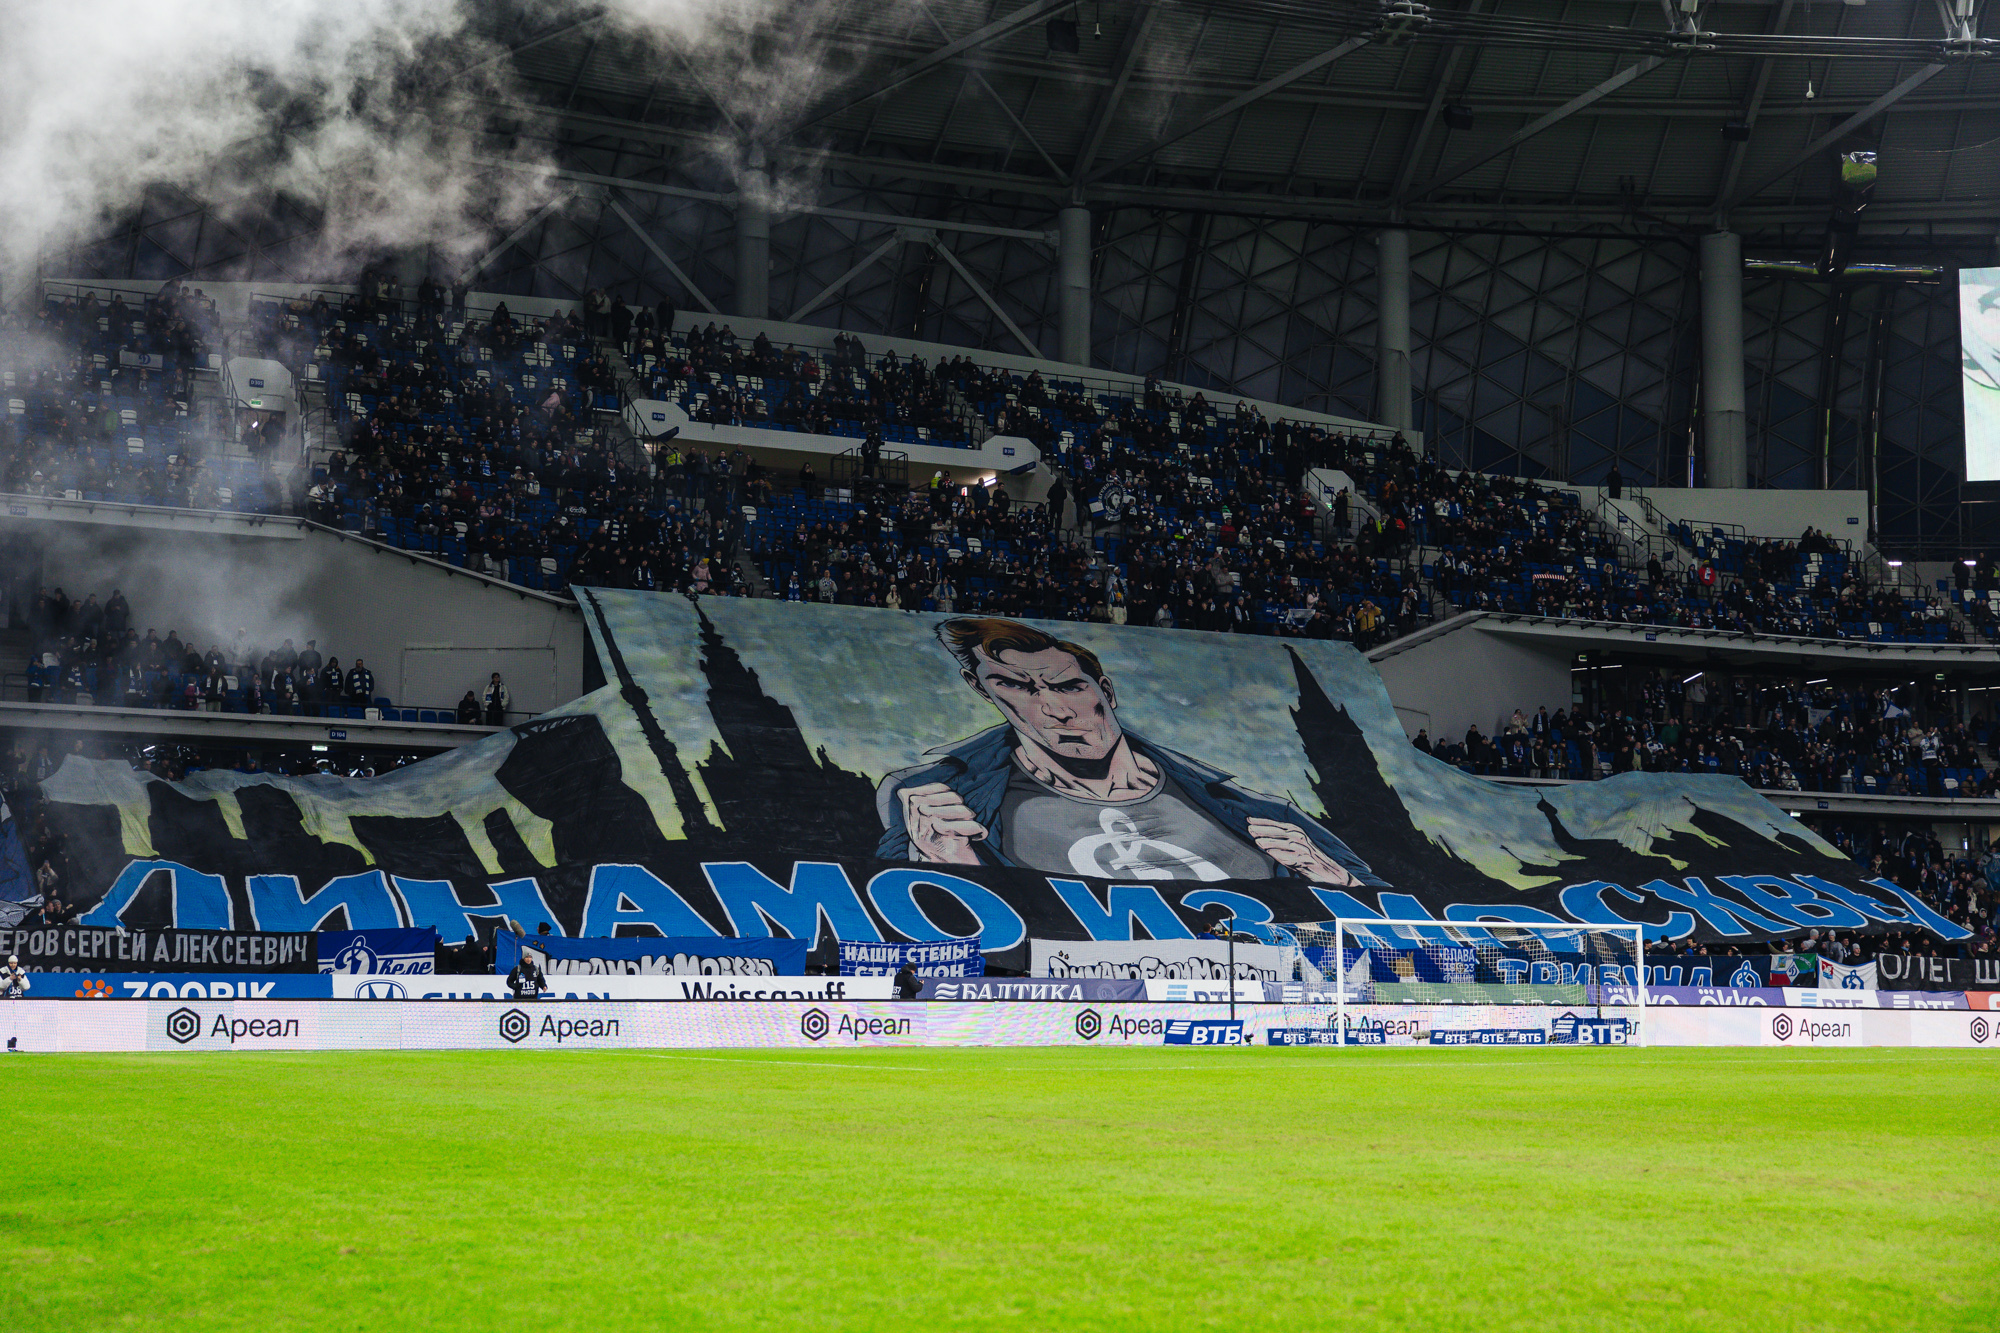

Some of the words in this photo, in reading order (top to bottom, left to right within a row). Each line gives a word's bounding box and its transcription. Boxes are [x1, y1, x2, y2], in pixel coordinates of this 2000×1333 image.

[64, 928, 146, 962] СЕРГЕЙ
[153, 933, 307, 965] АЛЕКСЕЕВИЧ
[845, 946, 900, 962] НАШИ
[1443, 948, 1475, 962] СЛАВА
[855, 964, 965, 978] СТАИОН
[1879, 953, 1960, 982] ОЛЕГ
[521, 981, 535, 989] 115
[211, 1014, 299, 1042] Ареал
[539, 1016, 619, 1042] Ареал
[838, 1015, 911, 1041] Ареал
[1109, 1014, 1167, 1040] Ареа
[1191, 1026, 1241, 1044] ВТБ
[1577, 1025, 1626, 1044] ВТБ
[1799, 1019, 1851, 1041] Ареал
[1283, 1034, 1306, 1043] ВТБ
[1358, 1033, 1381, 1043] ВТБ
[1445, 1034, 1467, 1043] ВТБ
[1482, 1034, 1504, 1043] ВТБ
[1519, 1033, 1541, 1043] ВТБ
